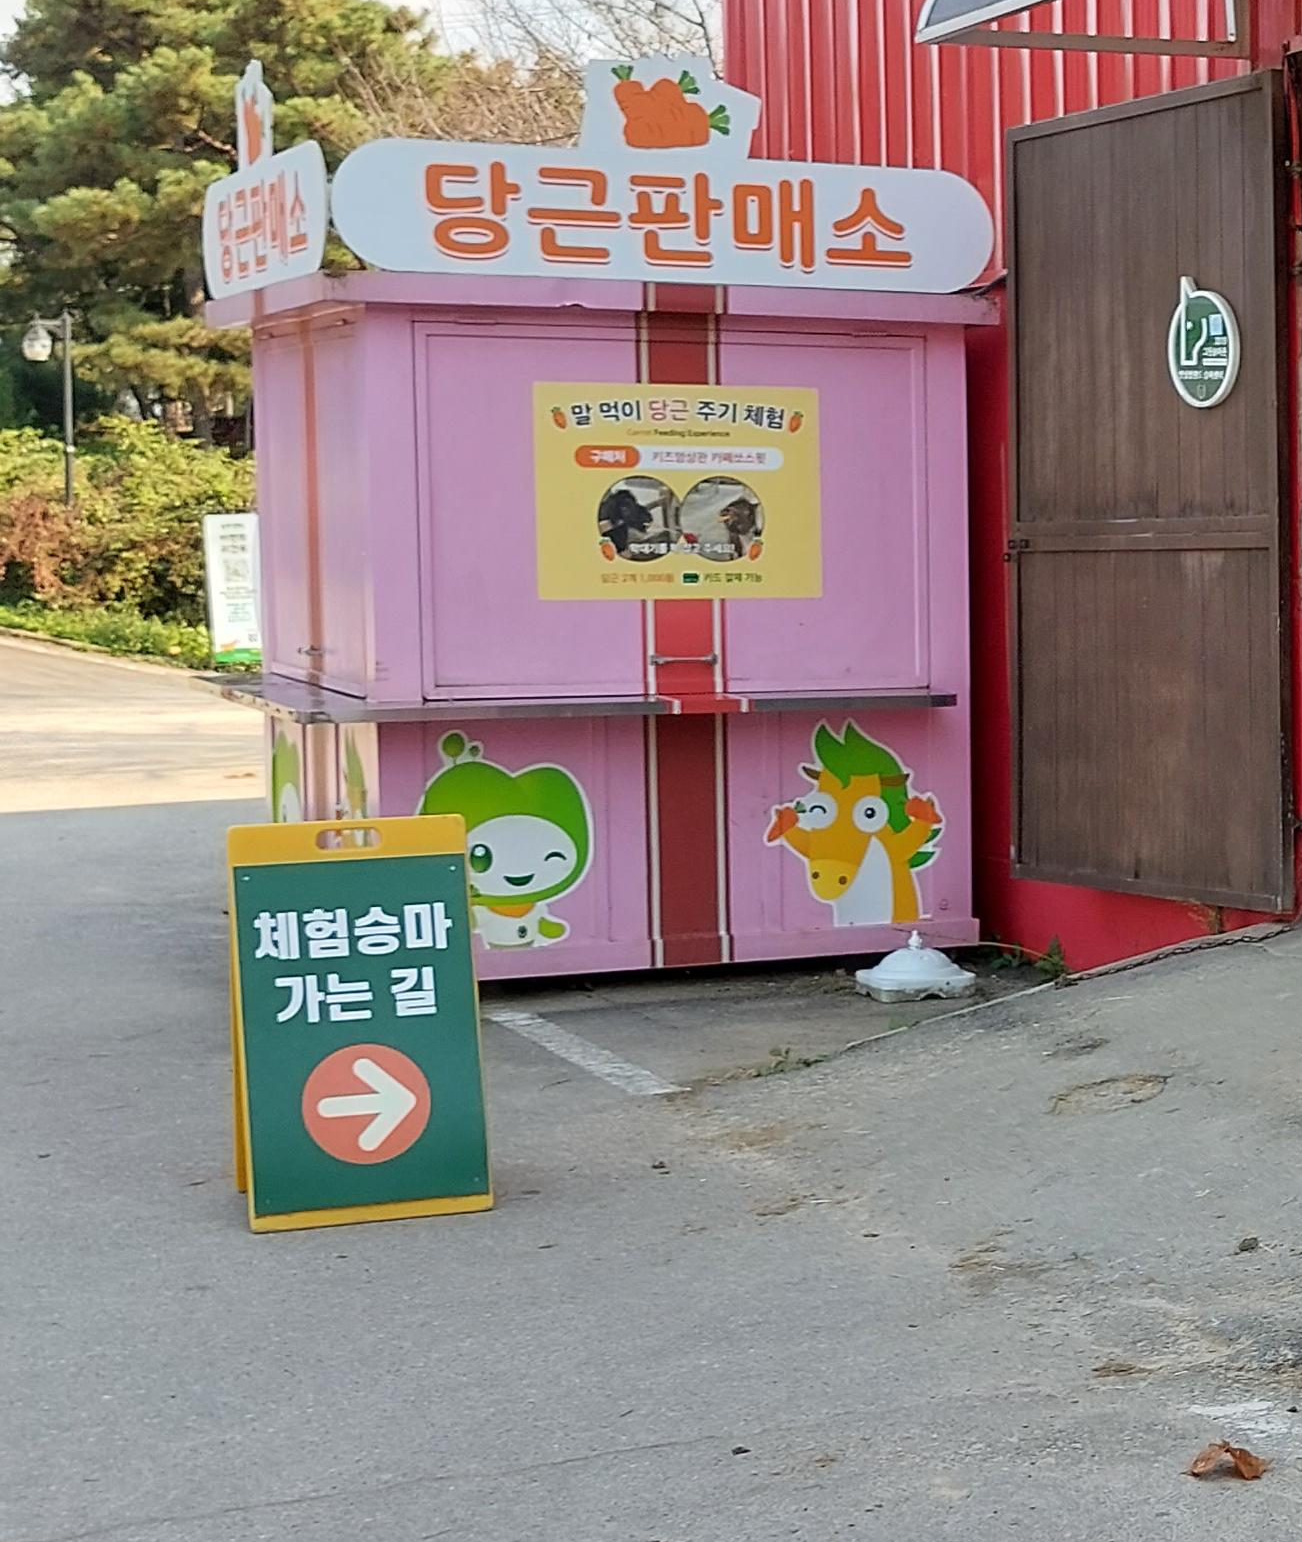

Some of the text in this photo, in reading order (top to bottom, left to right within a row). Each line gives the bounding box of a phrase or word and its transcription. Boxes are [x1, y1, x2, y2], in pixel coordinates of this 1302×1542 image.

[423, 160, 914, 273] 당근판매소
[571, 398, 785, 430] 말 먹이 당근 주기 체험
[653, 428, 686, 438] Feeding
[687, 429, 731, 438] Experience
[254, 901, 453, 960] 체험승마
[274, 966, 438, 1024] 가는 길
